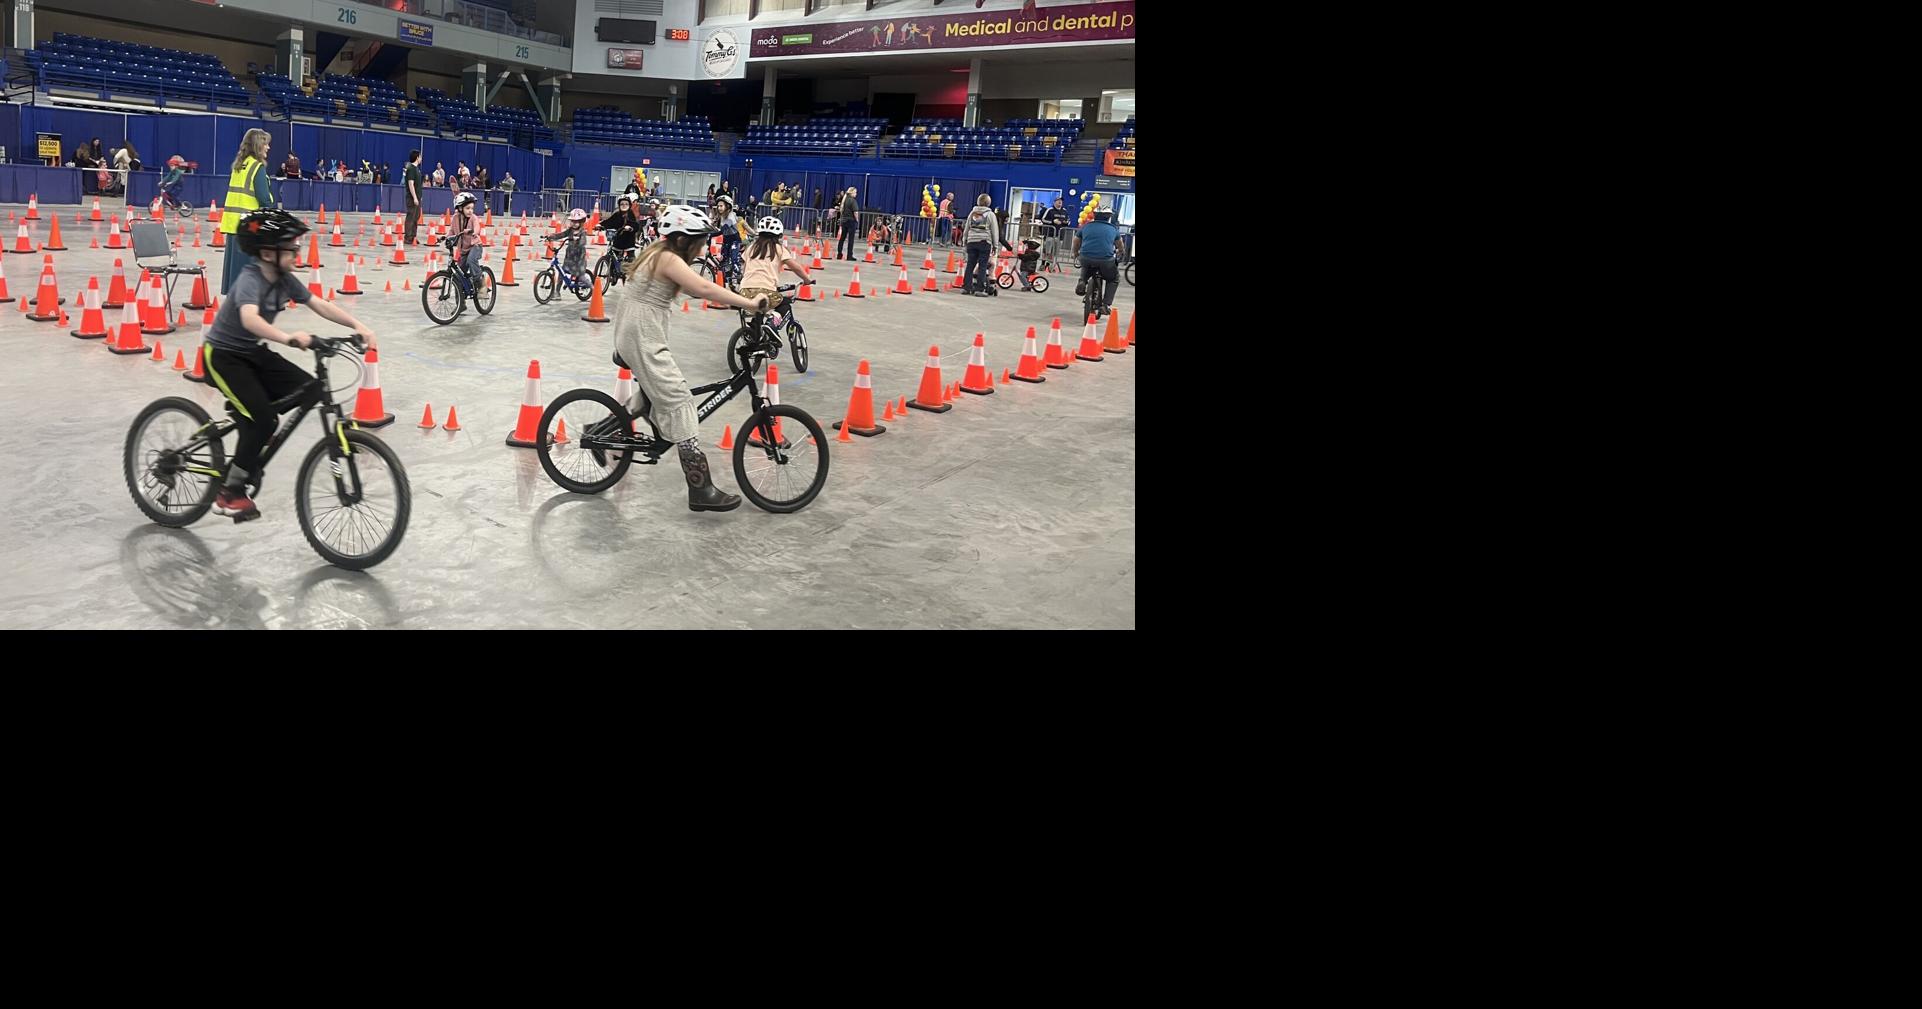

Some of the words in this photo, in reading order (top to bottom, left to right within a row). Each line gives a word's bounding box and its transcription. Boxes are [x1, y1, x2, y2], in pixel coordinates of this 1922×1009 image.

[337, 7, 357, 25] 216
[945, 18, 1012, 37] Medical
[1014, 16, 1049, 33] and
[1052, 11, 1118, 31] dental
[671, 29, 689, 39] 3:08
[757, 35, 778, 46] moda
[822, 32, 849, 45] Experience
[848, 27, 865, 35] better
[515, 45, 529, 59] 215
[705, 50, 727, 62] Tommy
[697, 385, 733, 418] STRIDER
